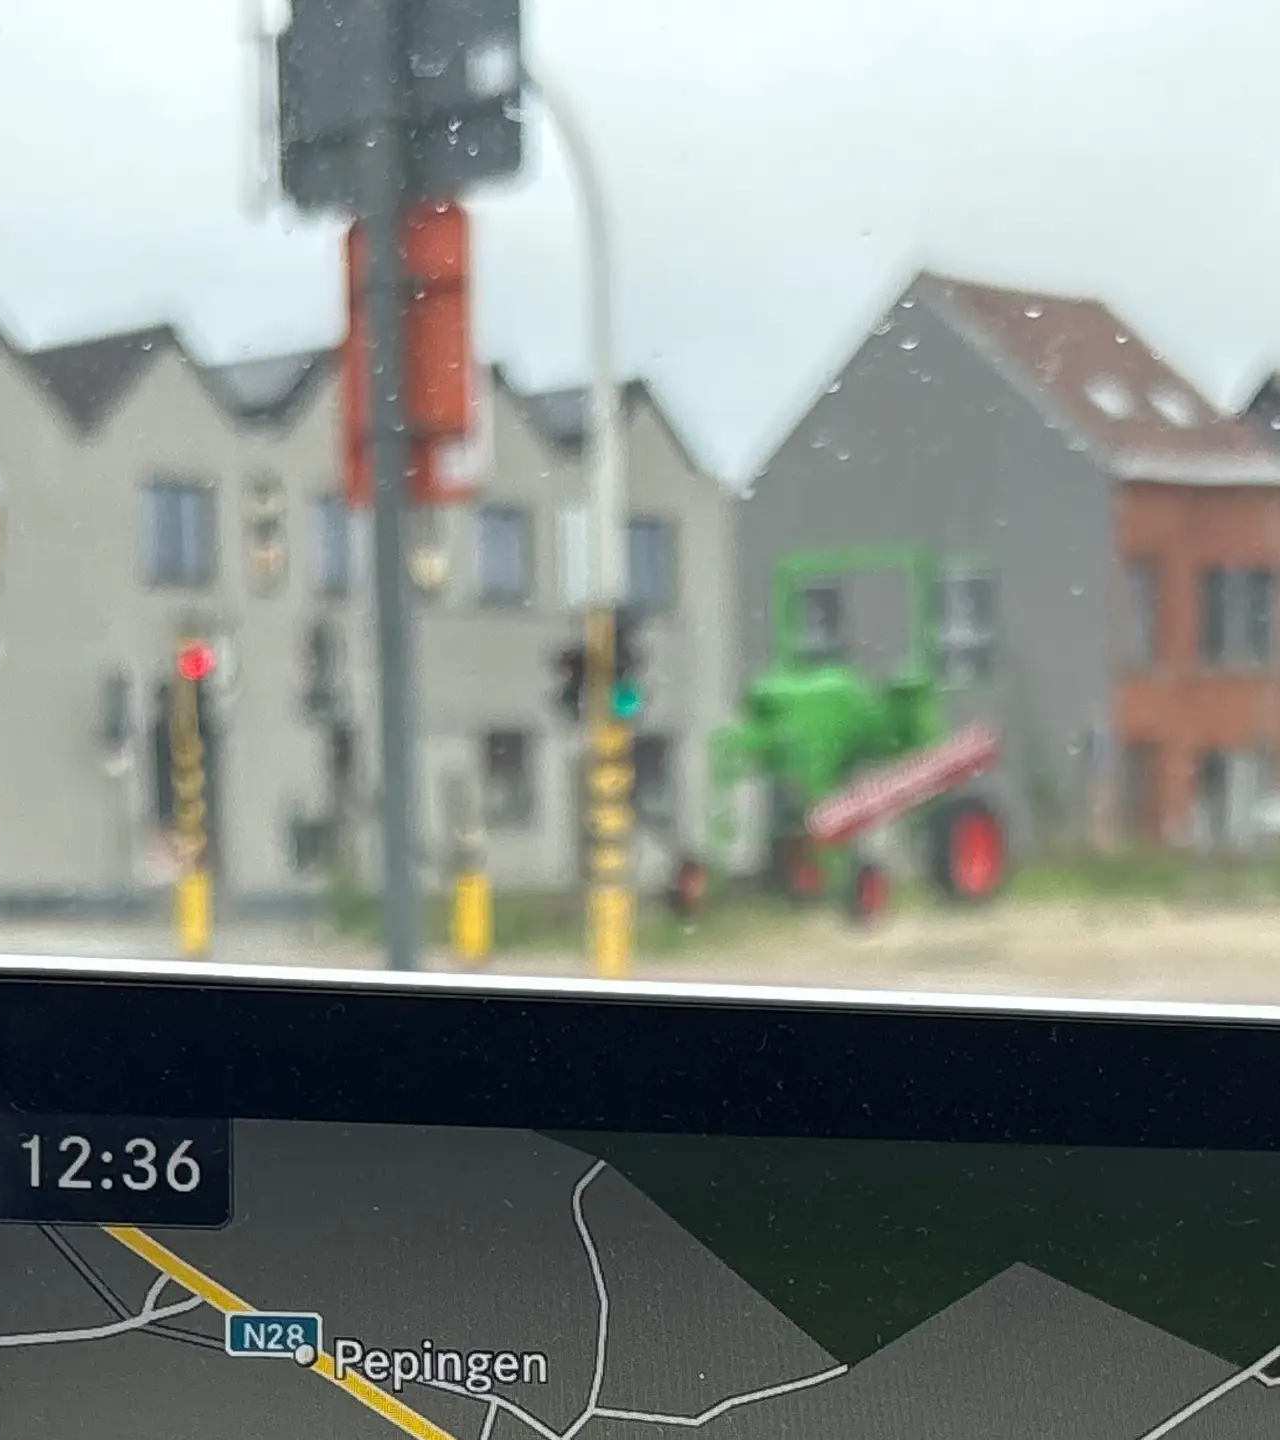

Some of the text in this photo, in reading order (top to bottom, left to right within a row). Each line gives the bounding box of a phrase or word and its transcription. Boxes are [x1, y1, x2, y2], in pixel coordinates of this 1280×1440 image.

[20, 1135, 202, 1192] 12:36
[242, 1323, 306, 1351] N28
[334, 1340, 549, 1392] Pepingen
